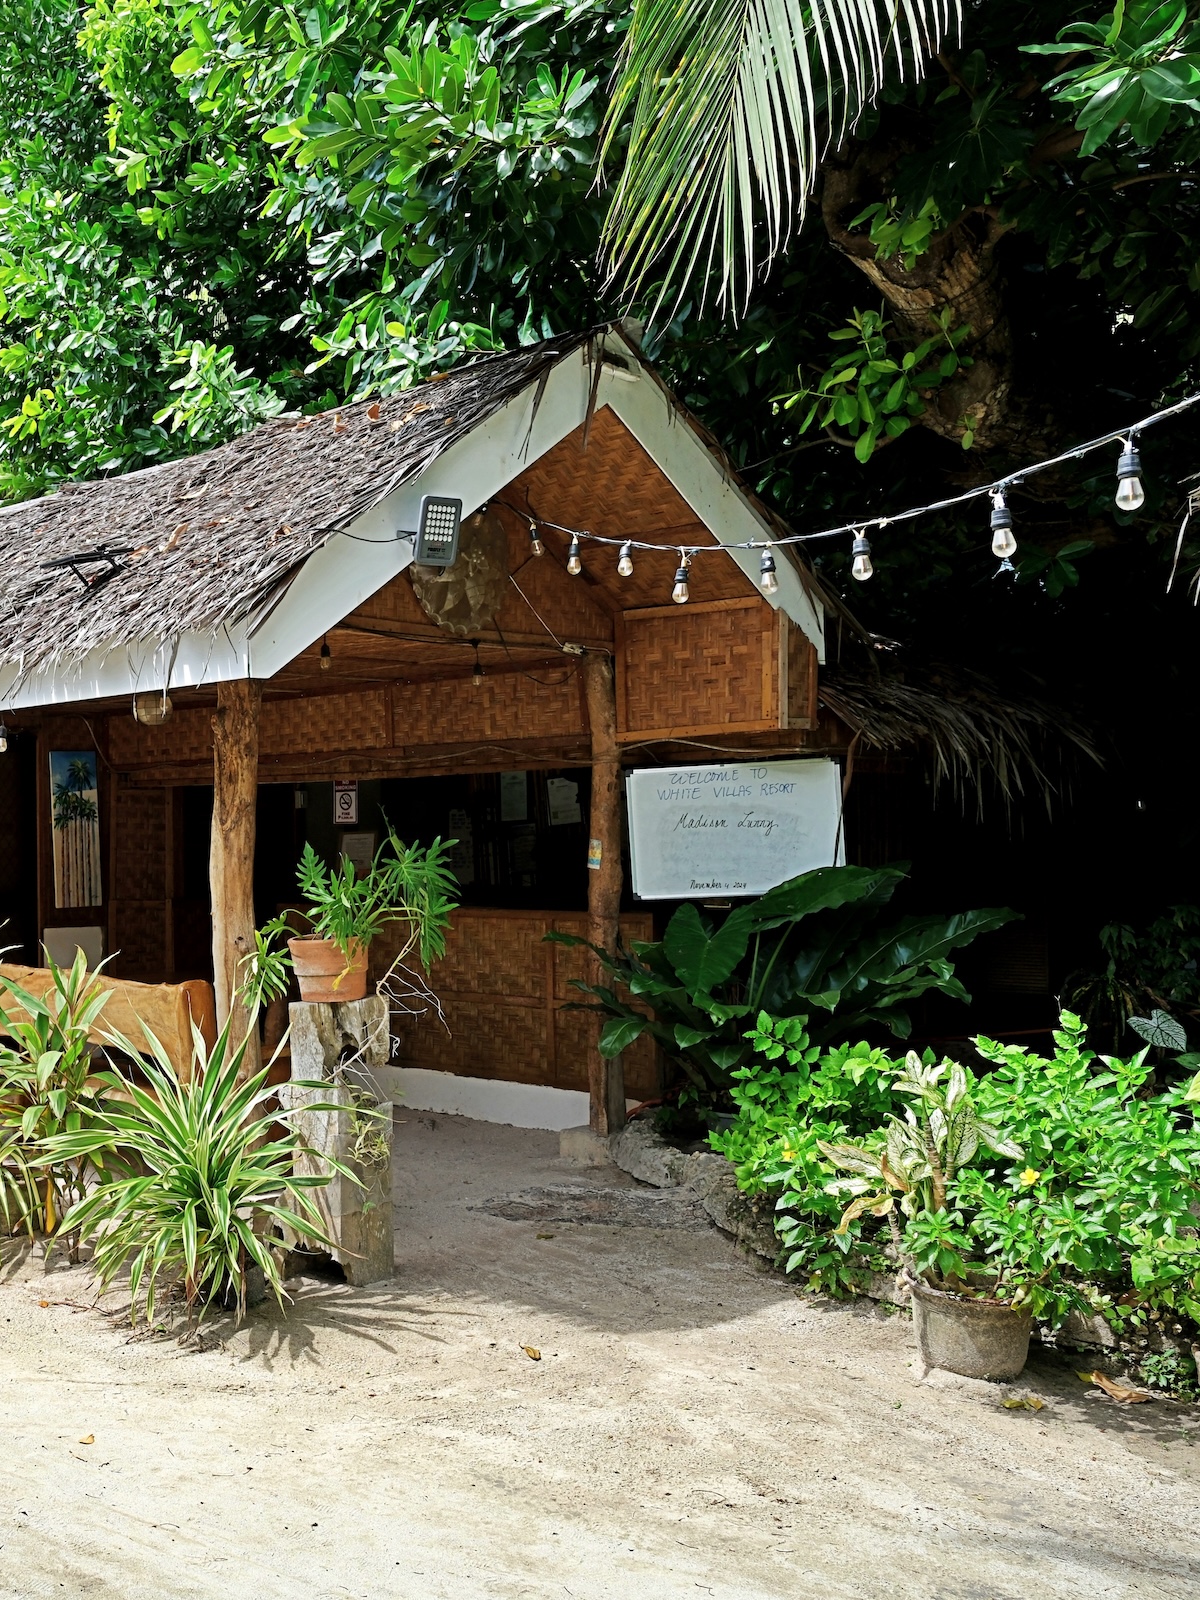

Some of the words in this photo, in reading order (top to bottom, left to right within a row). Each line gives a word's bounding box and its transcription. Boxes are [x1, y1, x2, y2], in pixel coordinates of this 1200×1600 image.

[669, 769, 738, 784] WELCOME
[750, 767, 768, 779] TO
[657, 787, 701, 800] WHITE
[713, 785, 752, 798] VILLAS
[760, 783, 797, 795] RESORT
[673, 812, 728, 831] Madison
[689, 879, 722, 889] November
